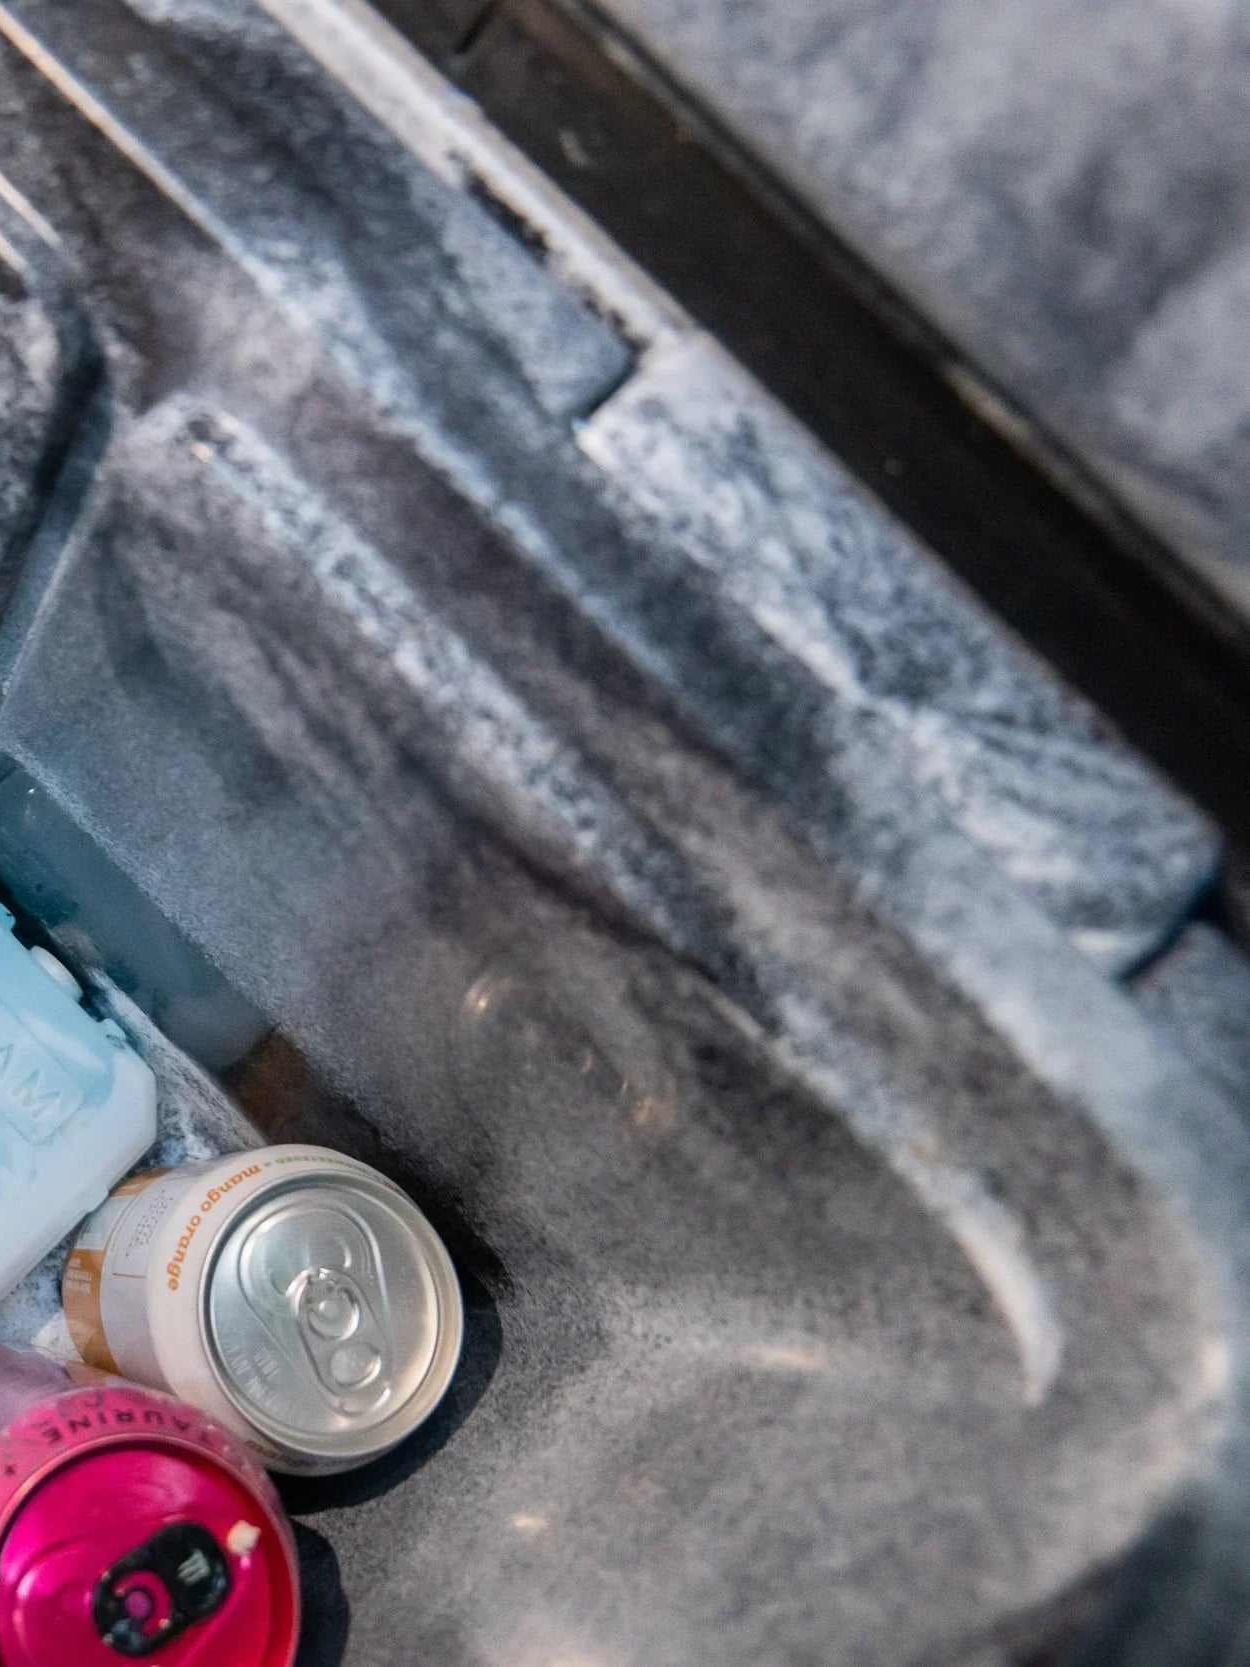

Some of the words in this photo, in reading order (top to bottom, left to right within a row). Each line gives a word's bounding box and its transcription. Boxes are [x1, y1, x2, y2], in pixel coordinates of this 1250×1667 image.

[200, 1164, 261, 1213] mango
[166, 1215, 202, 1292] orange
[40, 1409, 219, 1447] TAURINE
